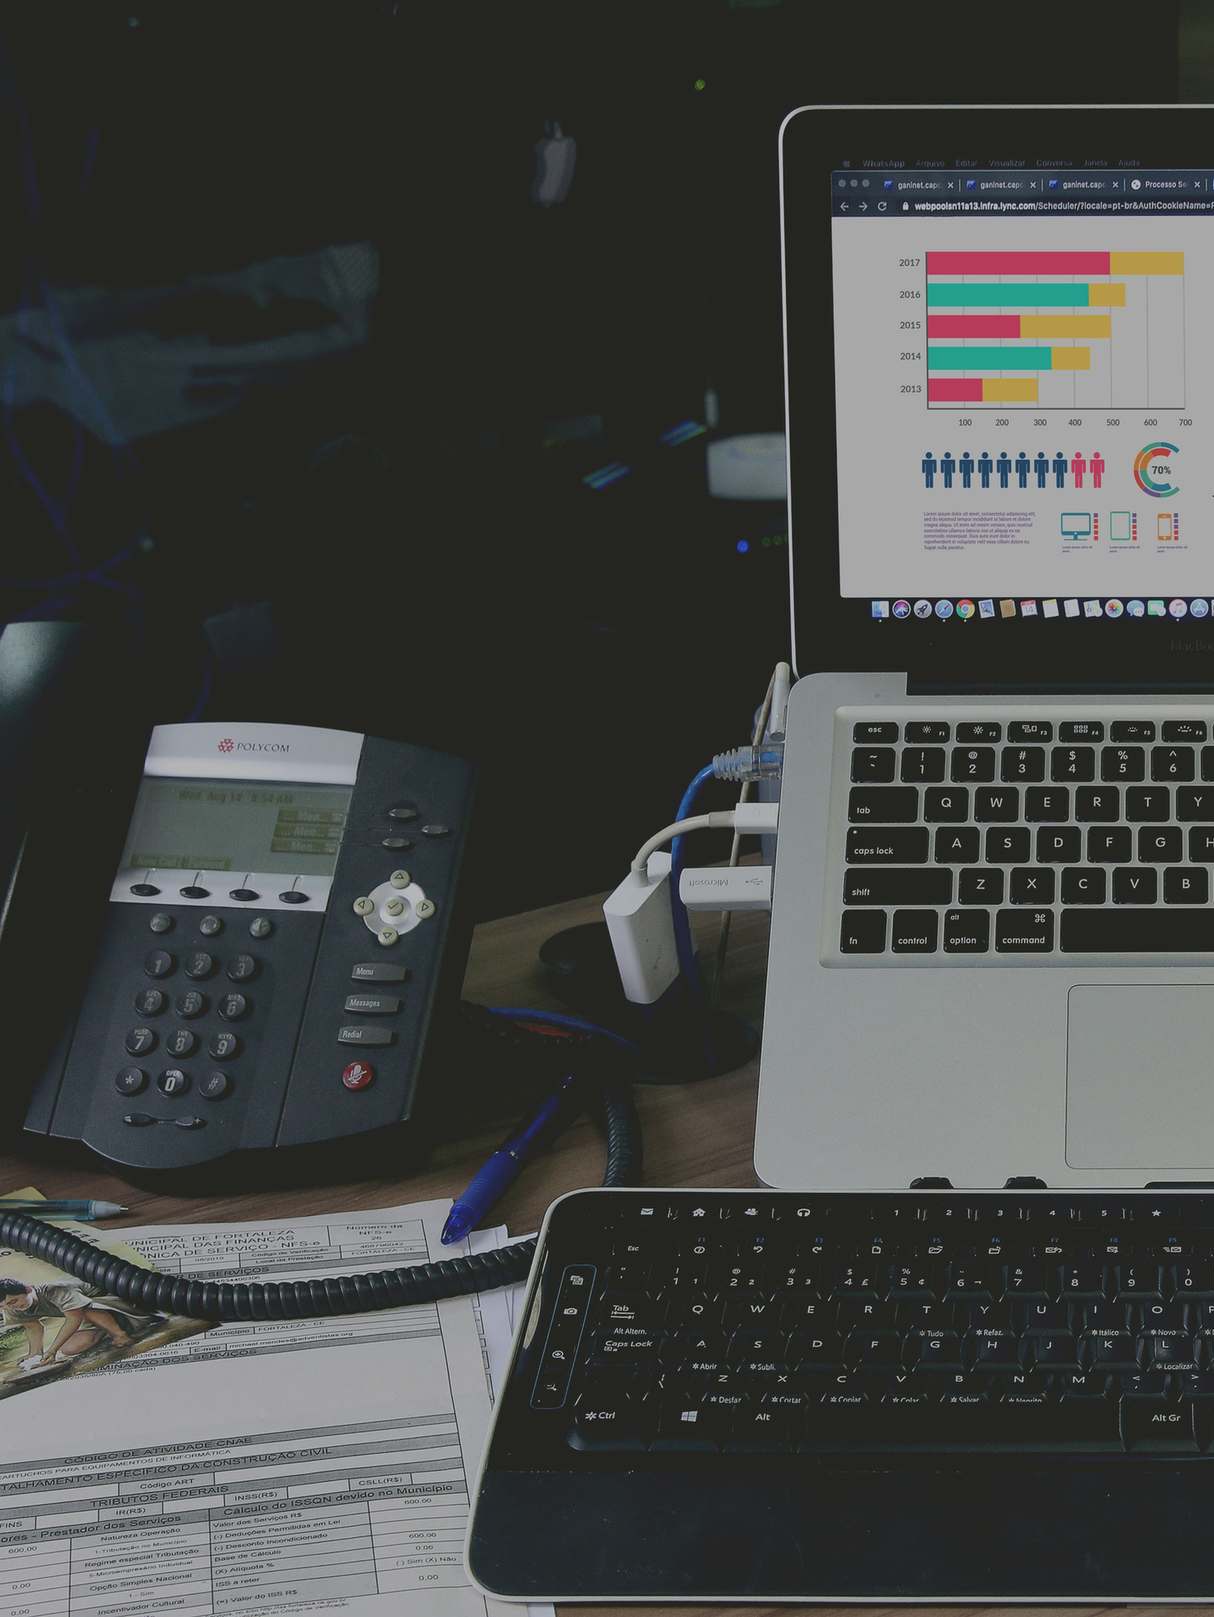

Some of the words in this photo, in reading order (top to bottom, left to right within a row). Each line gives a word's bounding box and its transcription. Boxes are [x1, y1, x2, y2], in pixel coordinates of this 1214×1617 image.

[1145, 181, 1177, 189] Processo
[899, 258, 921, 267] 2017
[899, 290, 921, 299] 2016
[899, 321, 921, 330] 2015
[900, 352, 921, 361] 2014
[900, 384, 922, 393] 2013
[959, 418, 973, 427] 100
[995, 418, 1010, 427] 200
[1033, 418, 1048, 427] 300
[1068, 418, 1082, 427] 400
[1106, 418, 1121, 427] 500
[1143, 418, 1158, 426] 600
[1178, 418, 1193, 427] 700
[1151, 464, 1171, 475] 70%
[236, 743, 291, 753] POLYCOM
[941, 797, 952, 808] Q
[990, 797, 1003, 808] W
[1043, 796, 1051, 808] E
[1093, 796, 1102, 807] R
[1143, 796, 1152, 808] T
[1193, 796, 1203, 807] Y
[854, 848, 875, 856] caps
[876, 847, 894, 855] lock
[951, 837, 962, 849] A
[1003, 837, 1012, 849] S
[1054, 837, 1064, 848] D
[1106, 837, 1113, 848] F
[1155, 837, 1166, 848] G
[689, 879, 729, 888] Microsoft
[851, 888, 870, 896] shift
[976, 879, 986, 890] Z
[1026, 878, 1037, 889] X
[1078, 878, 1088, 889] C
[1130, 878, 1140, 889] V
[1182, 878, 1191, 889] B
[849, 936, 858, 945] fn
[897, 936, 928, 945] control
[949, 936, 977, 946] option
[1002, 936, 1046, 944] command
[356, 967, 374, 976] Menu
[349, 998, 381, 1009] Messages
[343, 1030, 363, 1040] Redial
[215, 1230, 296, 1240] FORTALEZA
[226, 1235, 295, 1246] FINANÇAS
[208, 1244, 269, 1255] SERVIÇO
[613, 1304, 630, 1312] Tab
[599, 1411, 616, 1420] Ctrl
[755, 1413, 771, 1421] Alt
[1152, 1414, 1166, 1422] Alt
[1168, 1414, 1181, 1422] Gr
[64, 1452, 118, 1465] CÓDIGO
[121, 1449, 138, 1458] DE
[144, 1441, 211, 1456] ATIVIDADE
[216, 1437, 251, 1447] CNAE
[55, 1465, 79, 1474] PARA
[82, 1458, 154, 1471] EQUIPAMENTOS
[169, 1449, 231, 1461] INFORMÁTICA
[97, 1463, 178, 1481] ESPECÍFICO
[181, 1461, 201, 1472] DA
[203, 1450, 297, 1469] CONSTRUÇÃO
[300, 1446, 332, 1458] CIVIL
[140, 1480, 173, 1491] Código
[174, 1478, 195, 1486] ART
[358, 1477, 403, 1487] CSLL(R$)
[90, 1493, 160, 1508] TRIBUTOS
[163, 1485, 229, 1500] FEDERAIS
[223, 1504, 268, 1516] Cálculo
[272, 1502, 287, 1510] do
[291, 1496, 333, 1508] ISSQN
[335, 1490, 375, 1501] devido
[378, 1489, 393, 1497] no
[397, 1484, 453, 1496] Município
[115, 1507, 147, 1516] IR(R$)
[40, 1525, 100, 1539] Prestador
[103, 1521, 126, 1530] dos
[129, 1515, 182, 1527] Serviços
